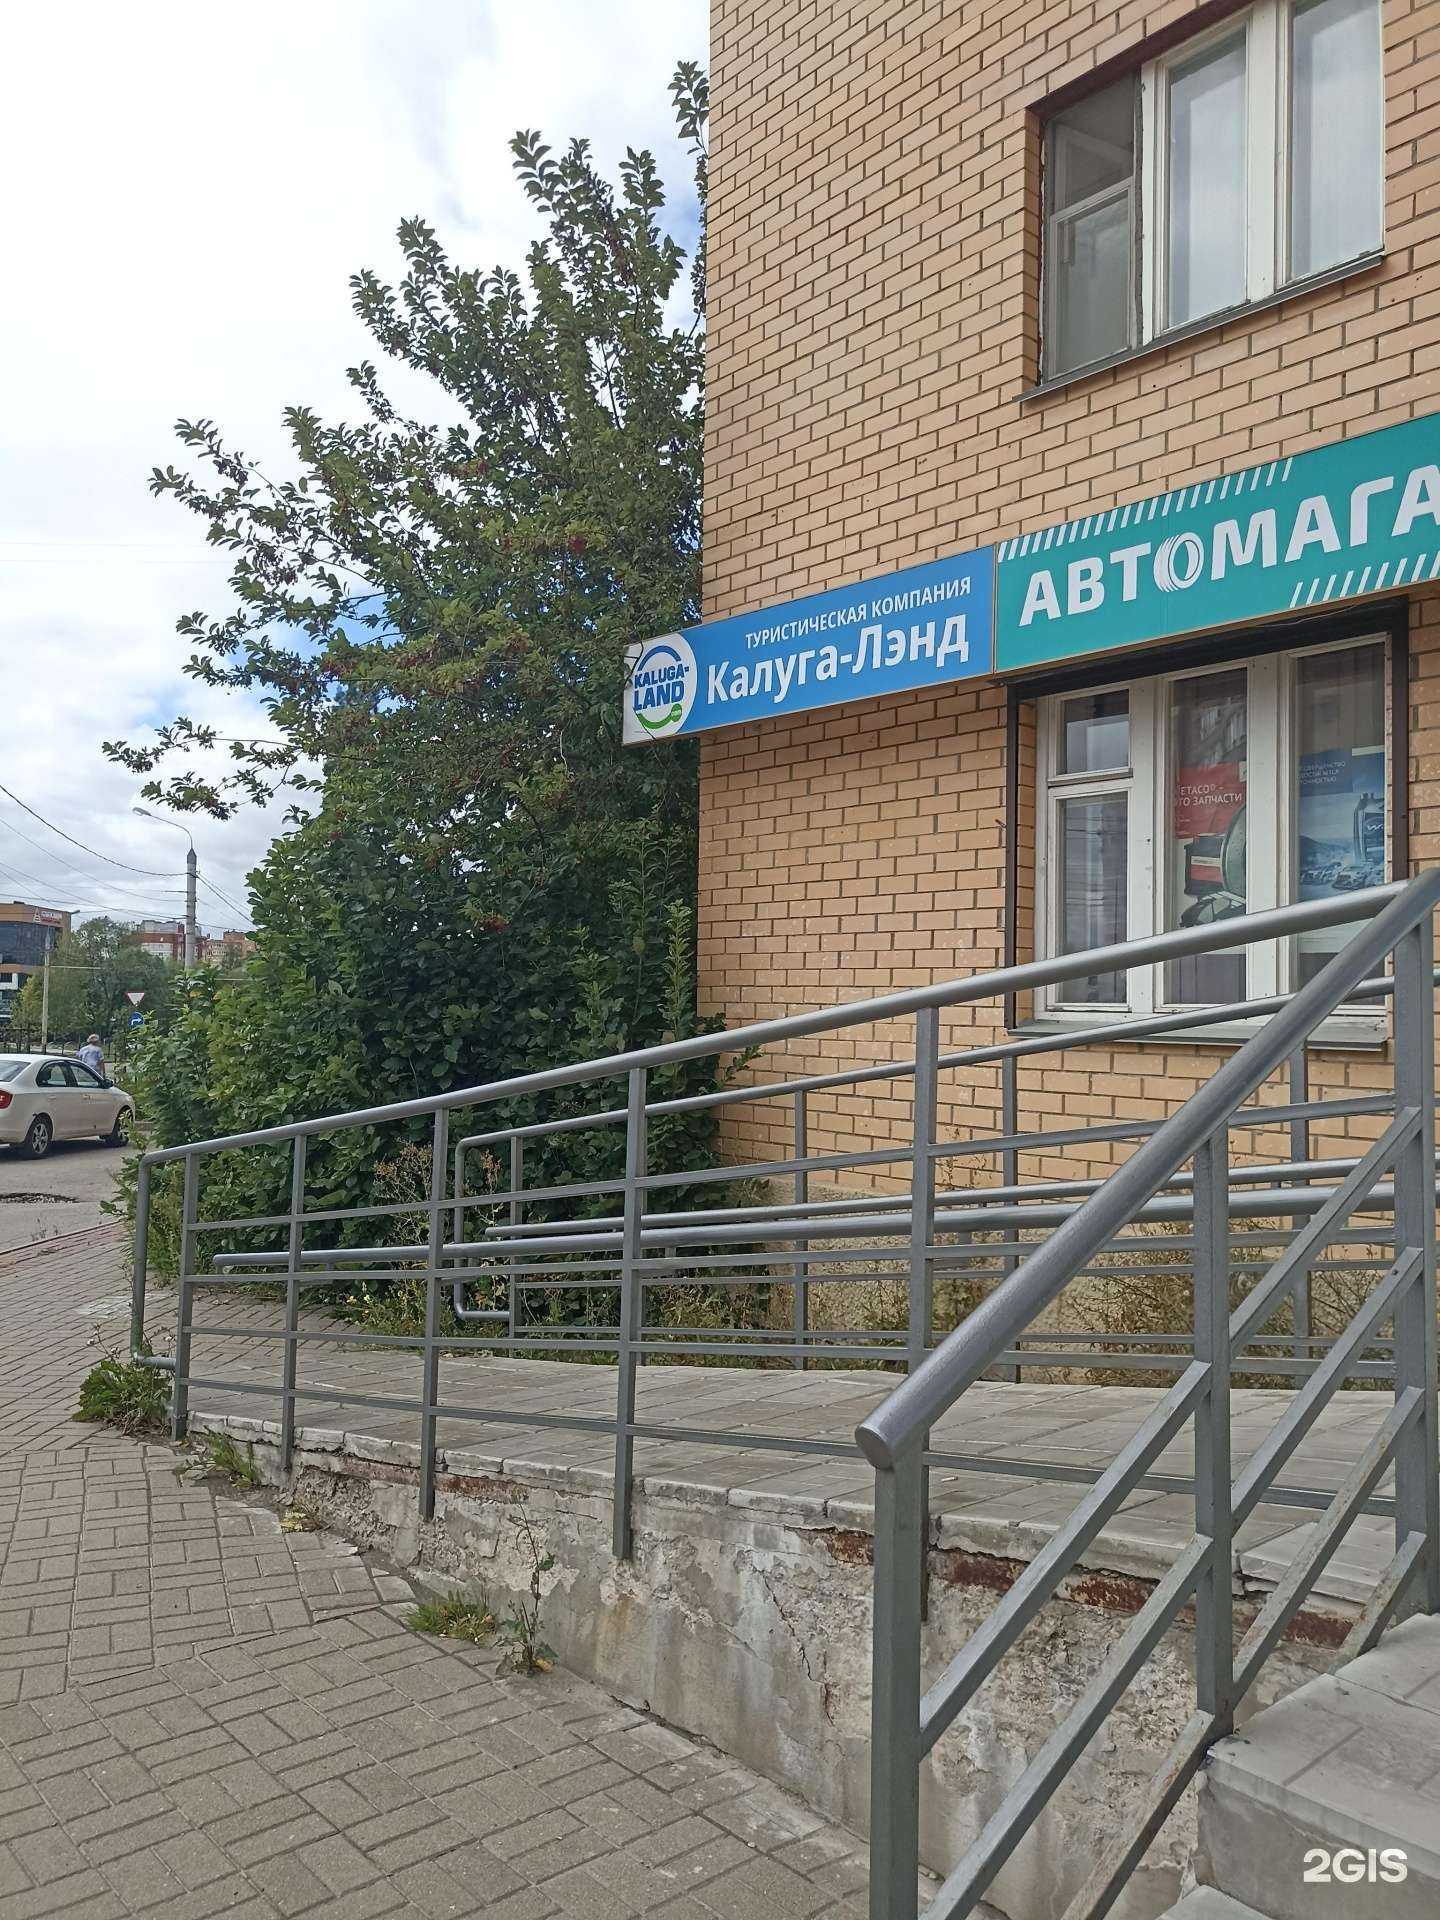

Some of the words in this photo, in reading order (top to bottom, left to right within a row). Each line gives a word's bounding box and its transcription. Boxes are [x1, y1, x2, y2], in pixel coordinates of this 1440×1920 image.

[1018, 464, 1440, 627] АВТОМАГА
[745, 602, 867, 649] ТУРИСТИЧЕСКАЯ
[871, 576, 971, 618] КОМПАНИЯ
[633, 680, 685, 711] LAND
[707, 614, 970, 705] Калуга-Лэнд
[1192, 792, 1242, 806] ЗАПЧАСТИ
